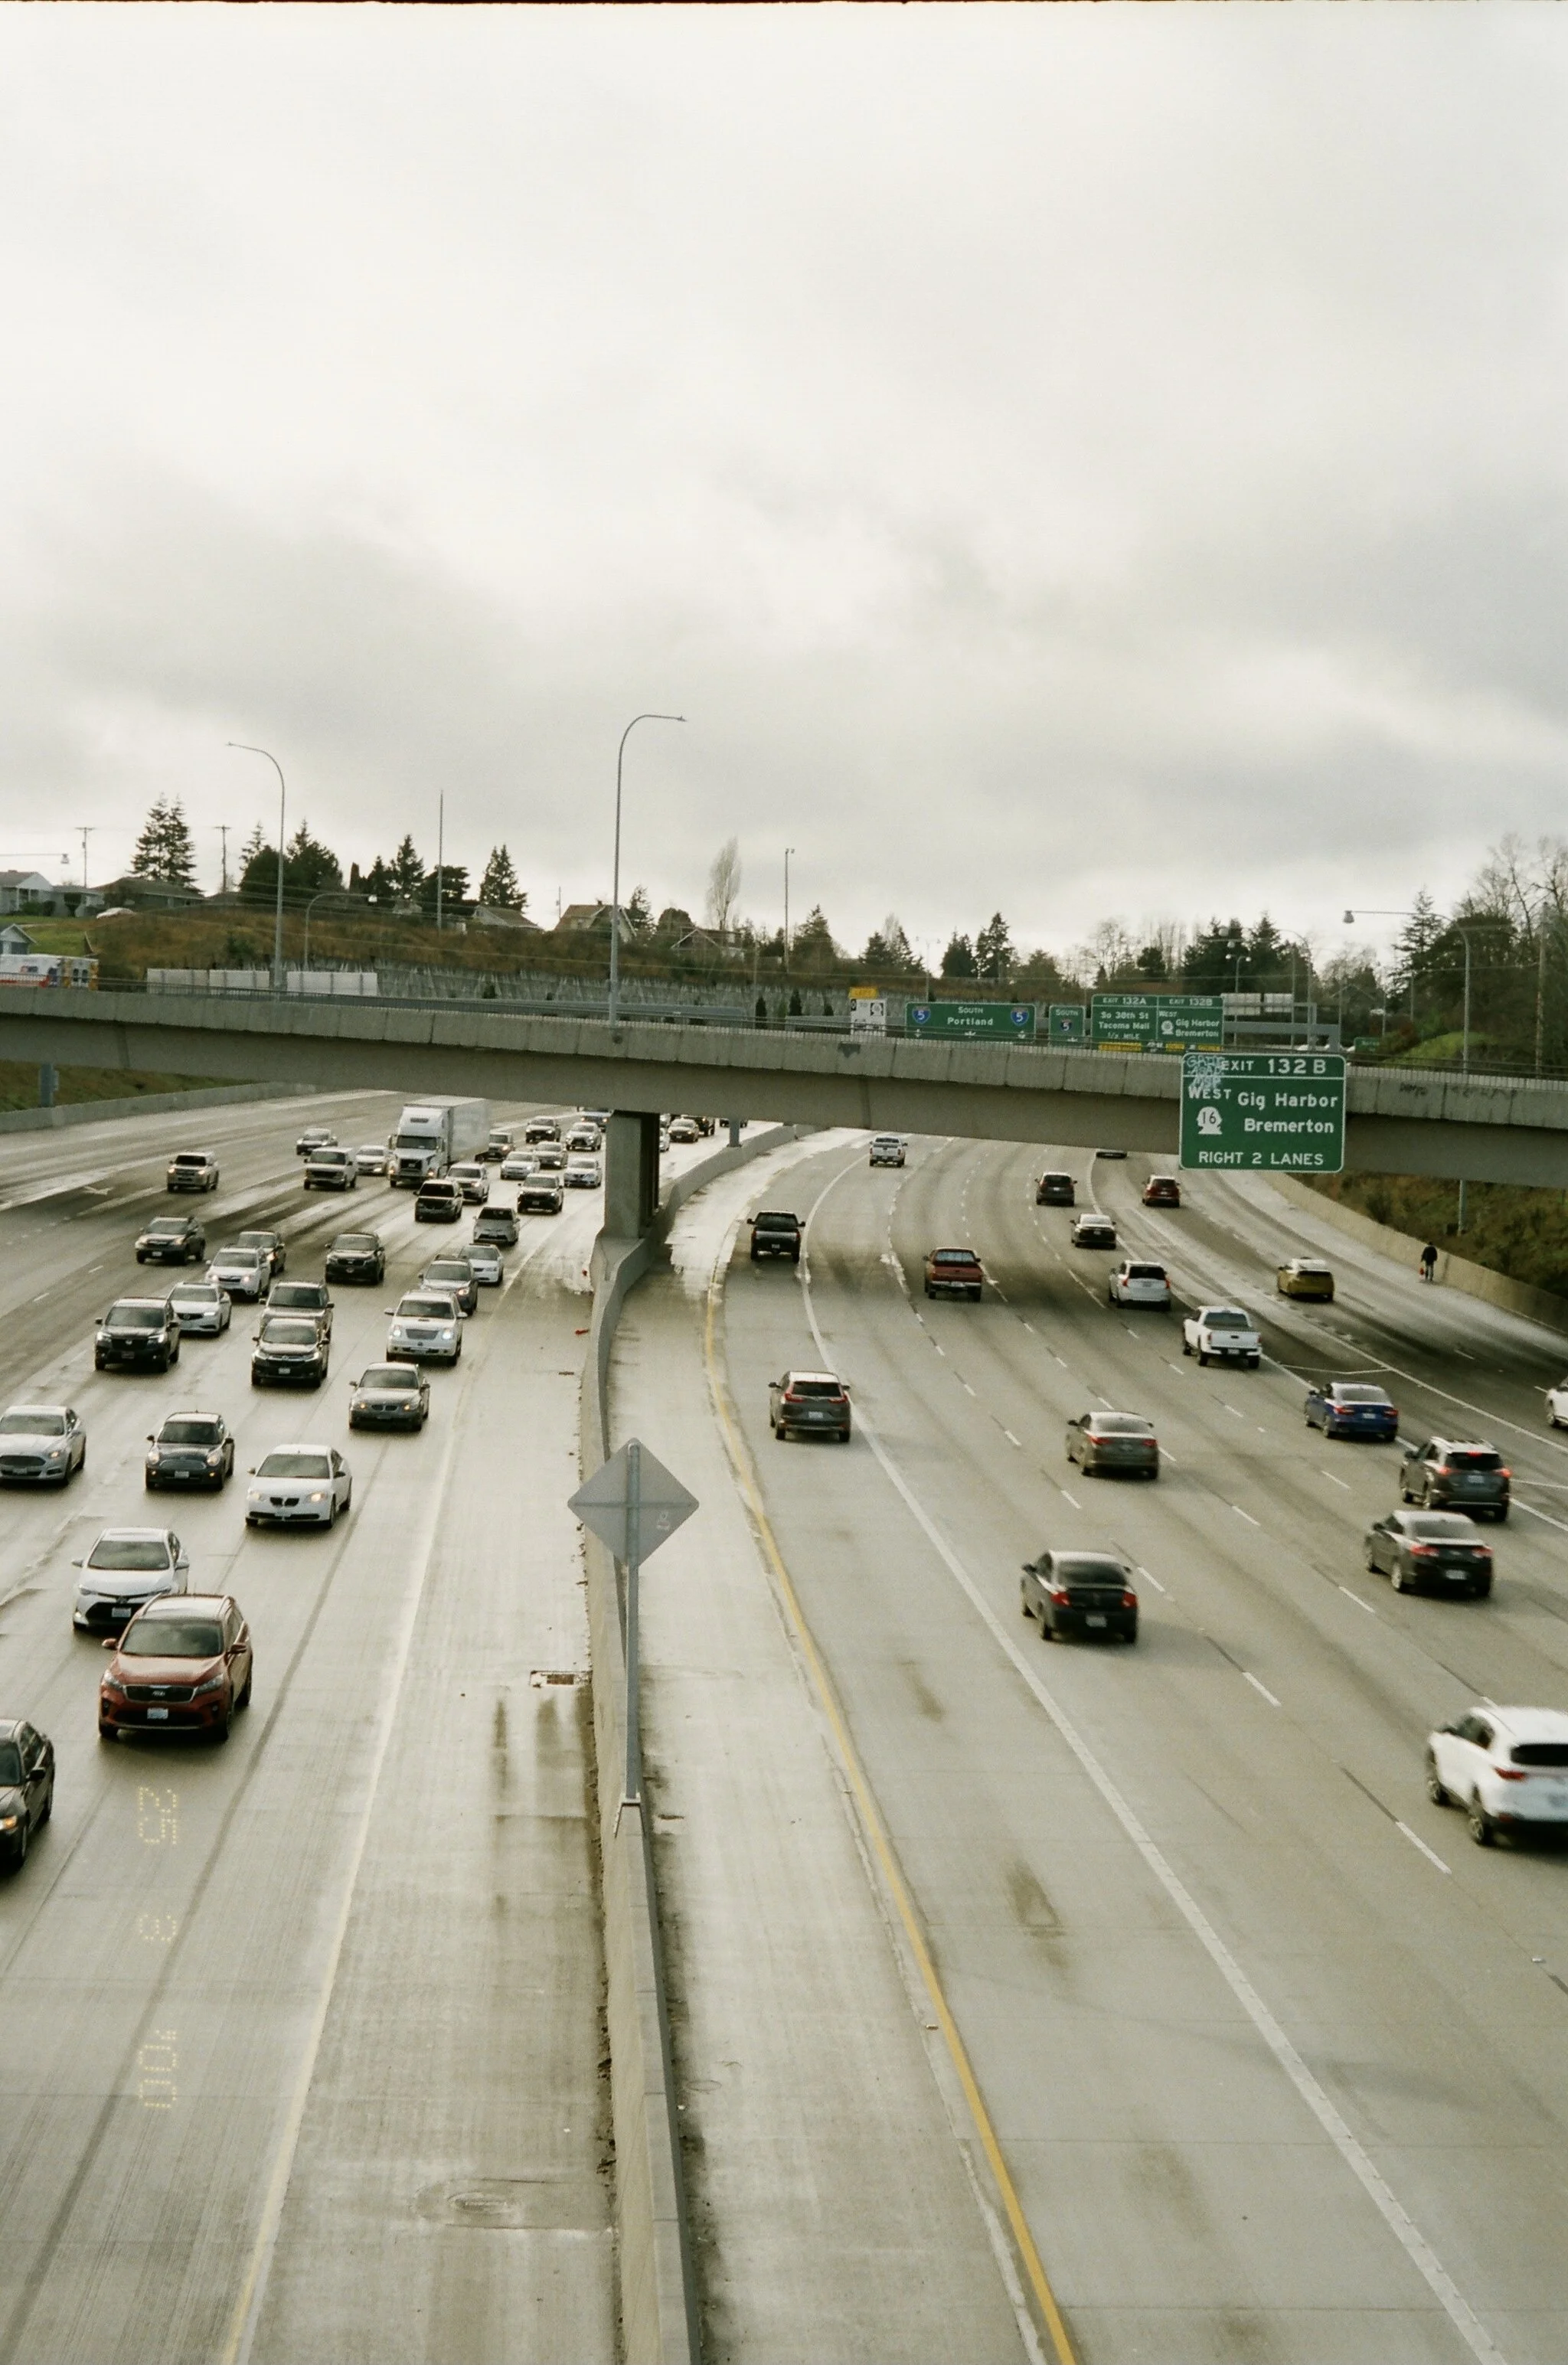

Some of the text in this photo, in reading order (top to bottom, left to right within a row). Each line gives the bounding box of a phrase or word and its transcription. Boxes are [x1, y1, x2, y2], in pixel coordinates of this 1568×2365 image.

[917, 1011, 925, 1020] 5
[1016, 1012, 1023, 1022] 5
[947, 1017, 994, 1026] Portland
[1062, 1022, 1069, 1031] 5
[1175, 1019, 1189, 1028] Gig
[1220, 1061, 1254, 1071] EXIT
[1188, 1086, 1231, 1099] WEST
[1237, 1093, 1338, 1110] Gig Harbor
[1201, 1111, 1217, 1124] 16
[1244, 1118, 1334, 1133] Bremerton
[1198, 1151, 1324, 1165] RIGHT 2 LANES
